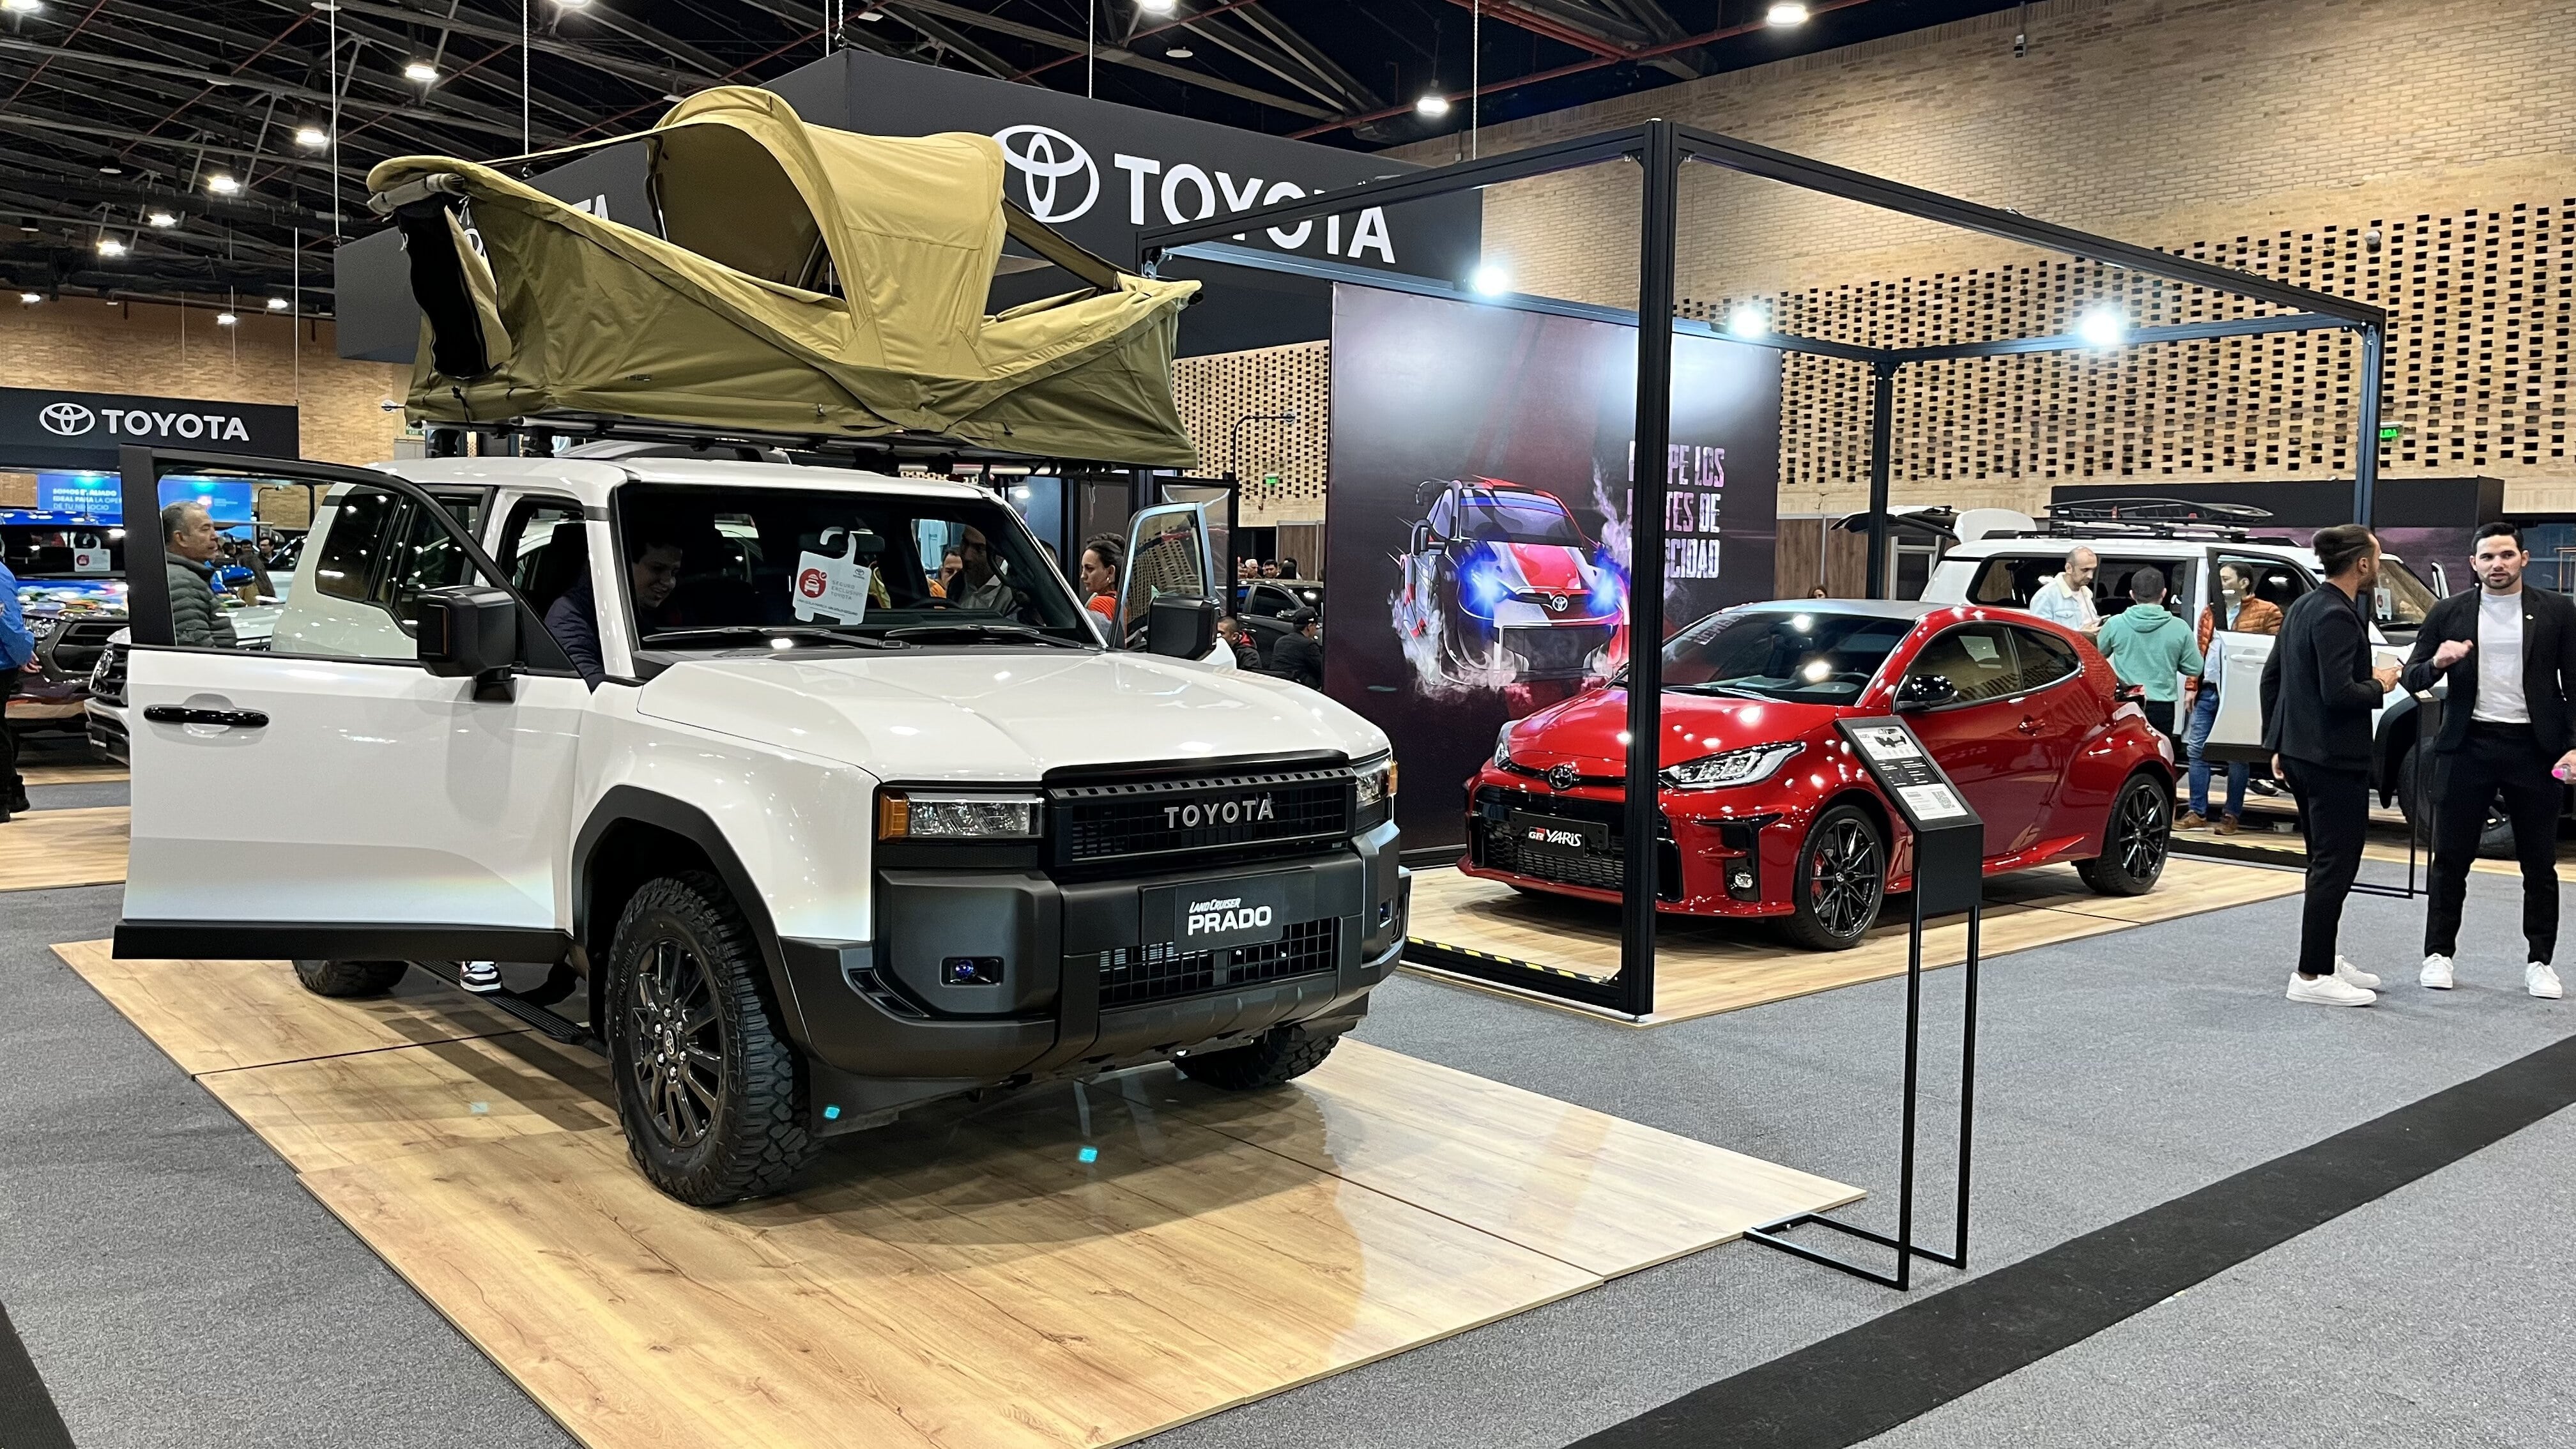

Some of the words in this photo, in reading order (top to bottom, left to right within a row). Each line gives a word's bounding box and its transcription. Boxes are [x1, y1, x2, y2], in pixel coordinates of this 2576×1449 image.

[101, 409, 250, 441] TOYOTA
[1694, 447, 1725, 487] LOS
[1699, 493, 1721, 533] DE
[831, 592, 852, 600] TOYOTA
[832, 580, 855, 589] SEGURO
[1164, 799, 1274, 829] TOYOTA
[1528, 831, 1544, 841] GR
[1188, 905, 1272, 936] PRADO
